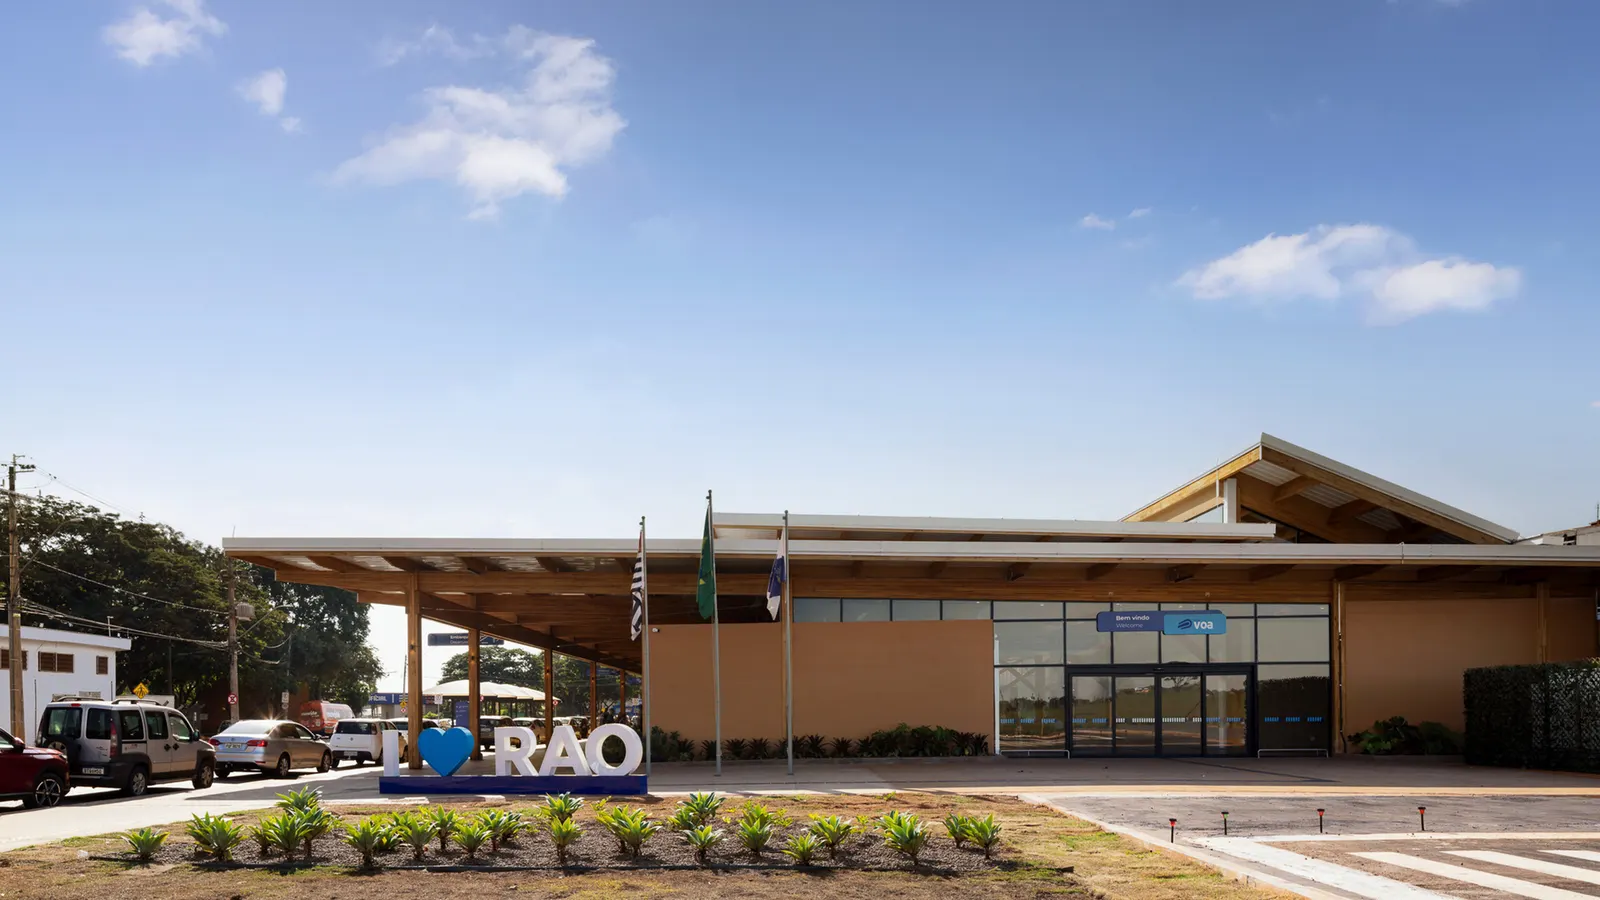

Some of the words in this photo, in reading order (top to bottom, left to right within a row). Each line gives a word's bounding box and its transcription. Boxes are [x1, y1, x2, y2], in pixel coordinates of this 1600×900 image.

[1193, 621, 1214, 630] voa
[382, 730, 400, 776] I
[494, 724, 644, 776] RAO
